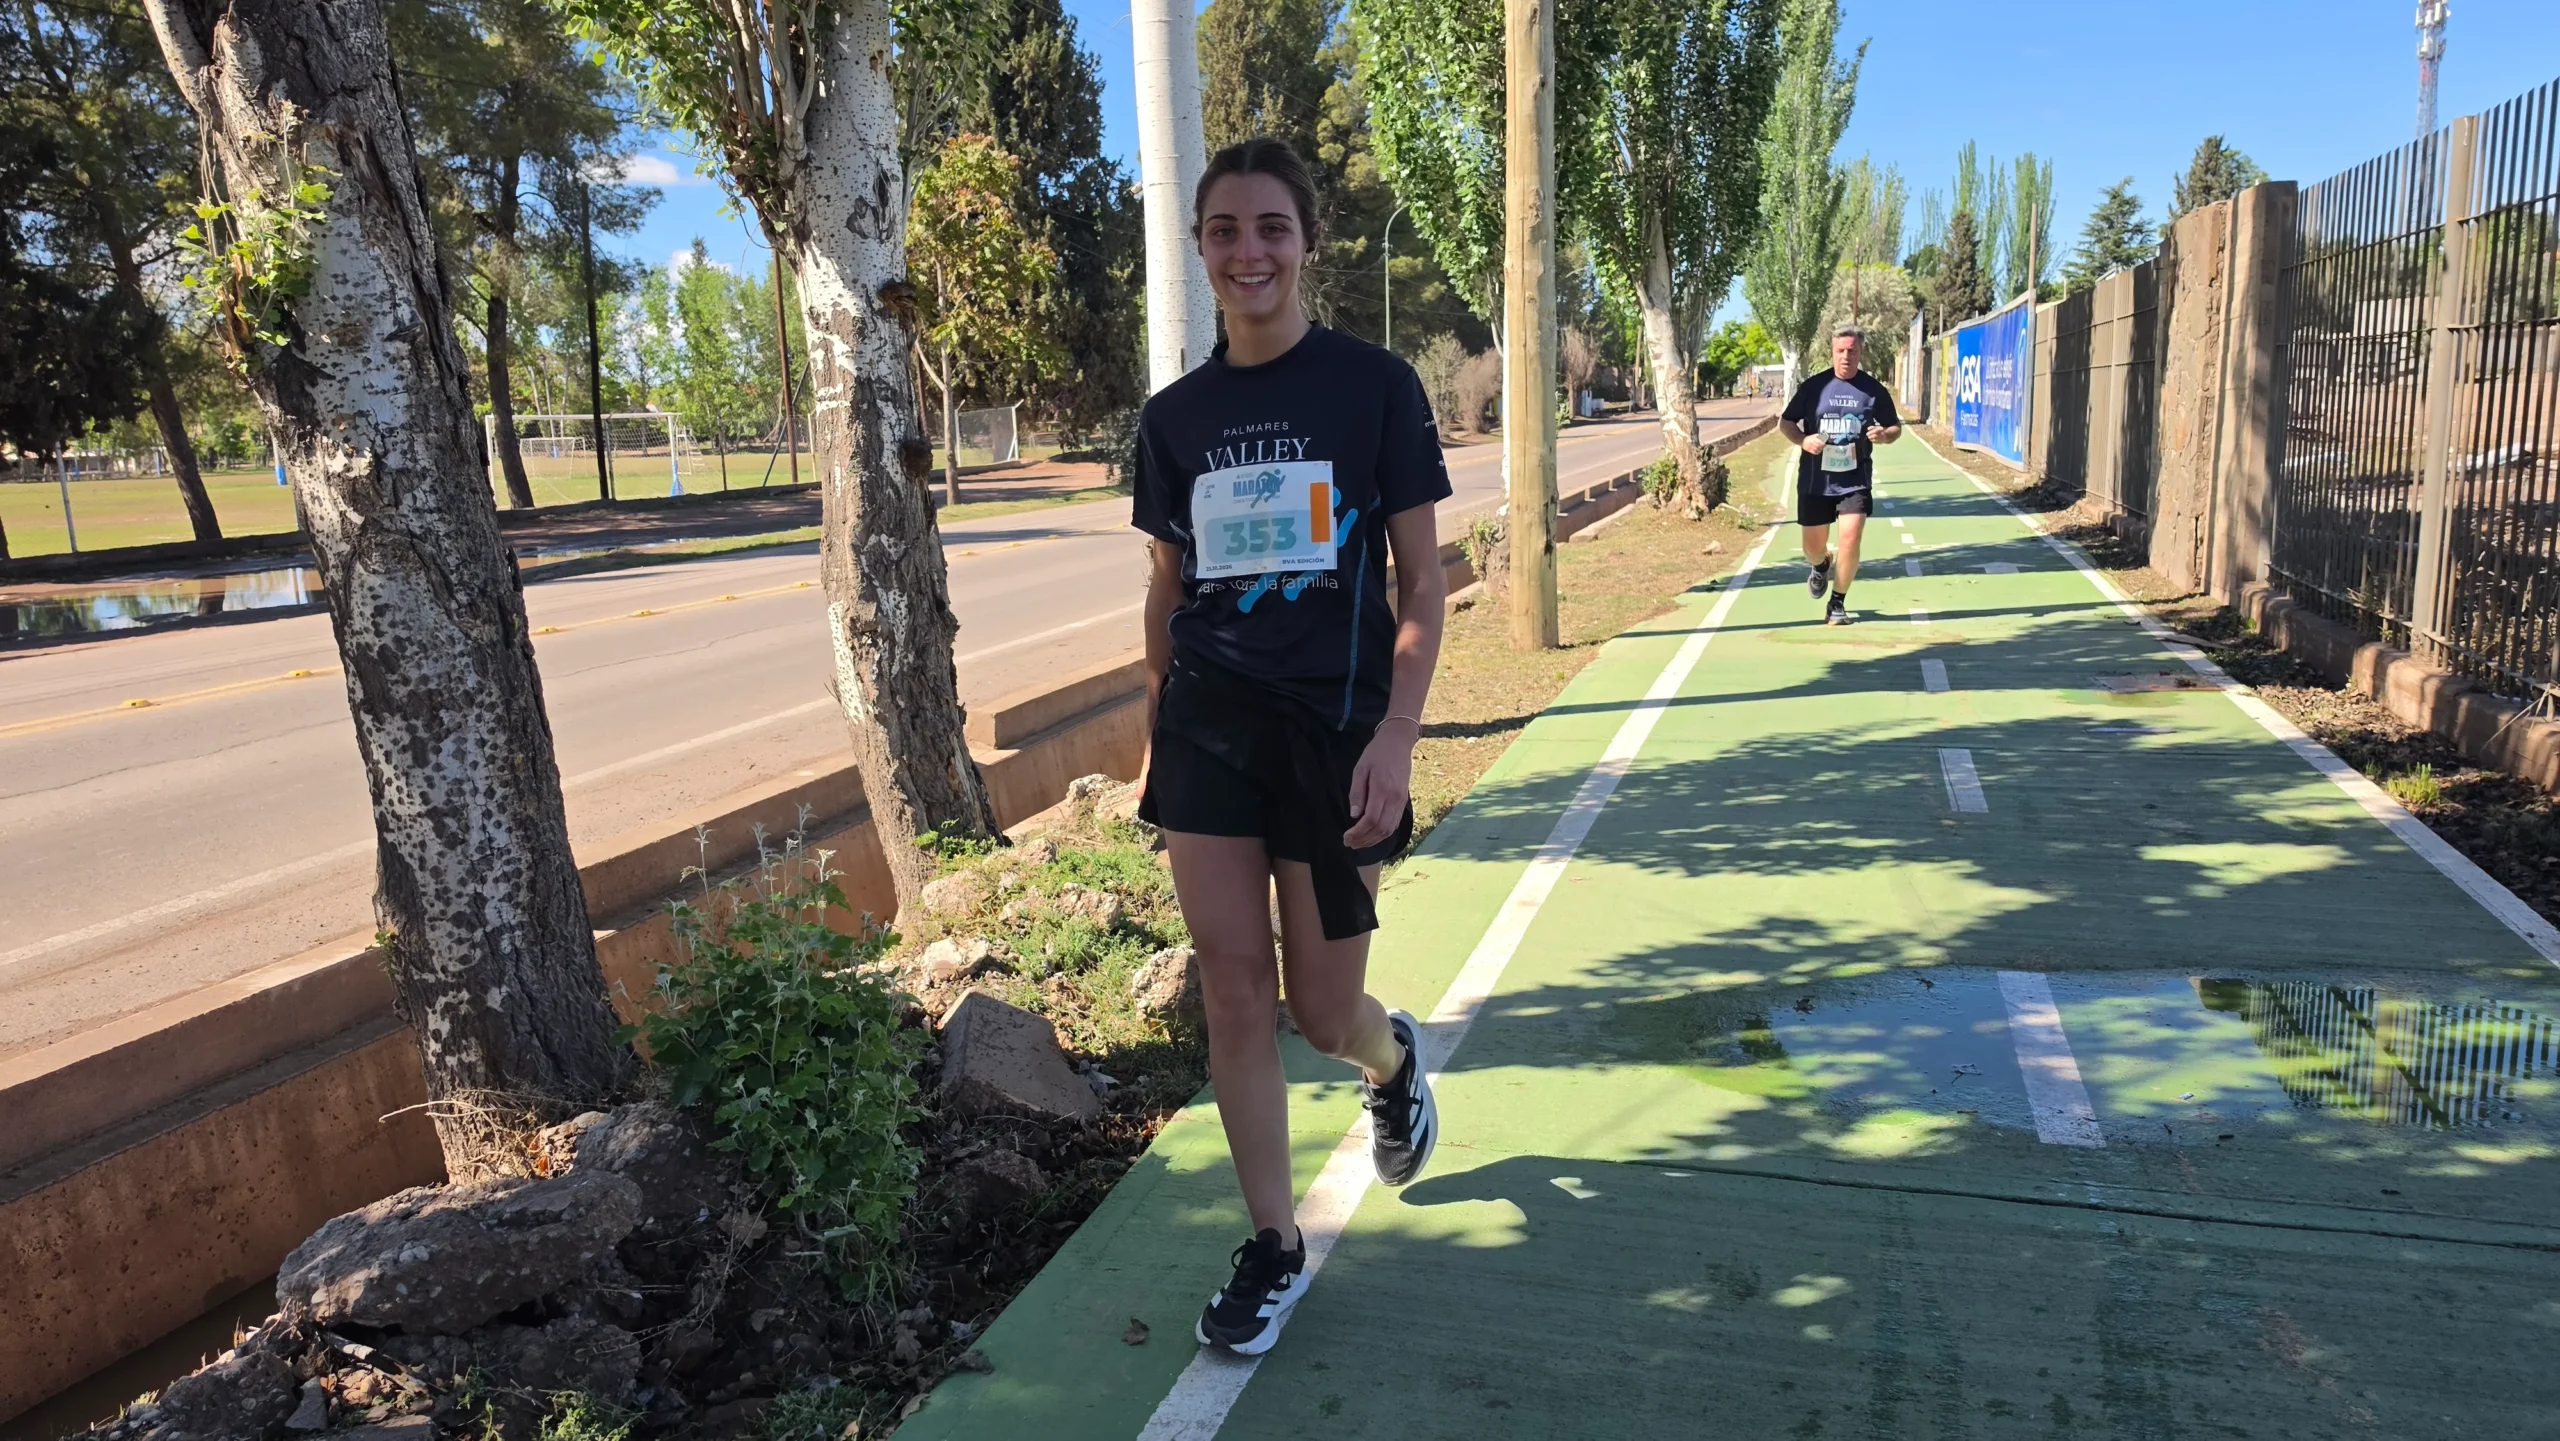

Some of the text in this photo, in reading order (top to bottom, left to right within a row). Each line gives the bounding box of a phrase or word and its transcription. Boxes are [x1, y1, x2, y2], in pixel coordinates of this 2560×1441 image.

[1960, 355, 1982, 404] GSA
[1829, 399, 1859, 408] VALLEY
[1223, 421, 1290, 439] PALMARES
[1205, 437, 1312, 472] VALLEY
[1222, 516, 1297, 556] 353
[1297, 556, 1325, 564] EDICIÓN
[1264, 576, 1277, 590] la
[1281, 573, 1339, 590] familia
